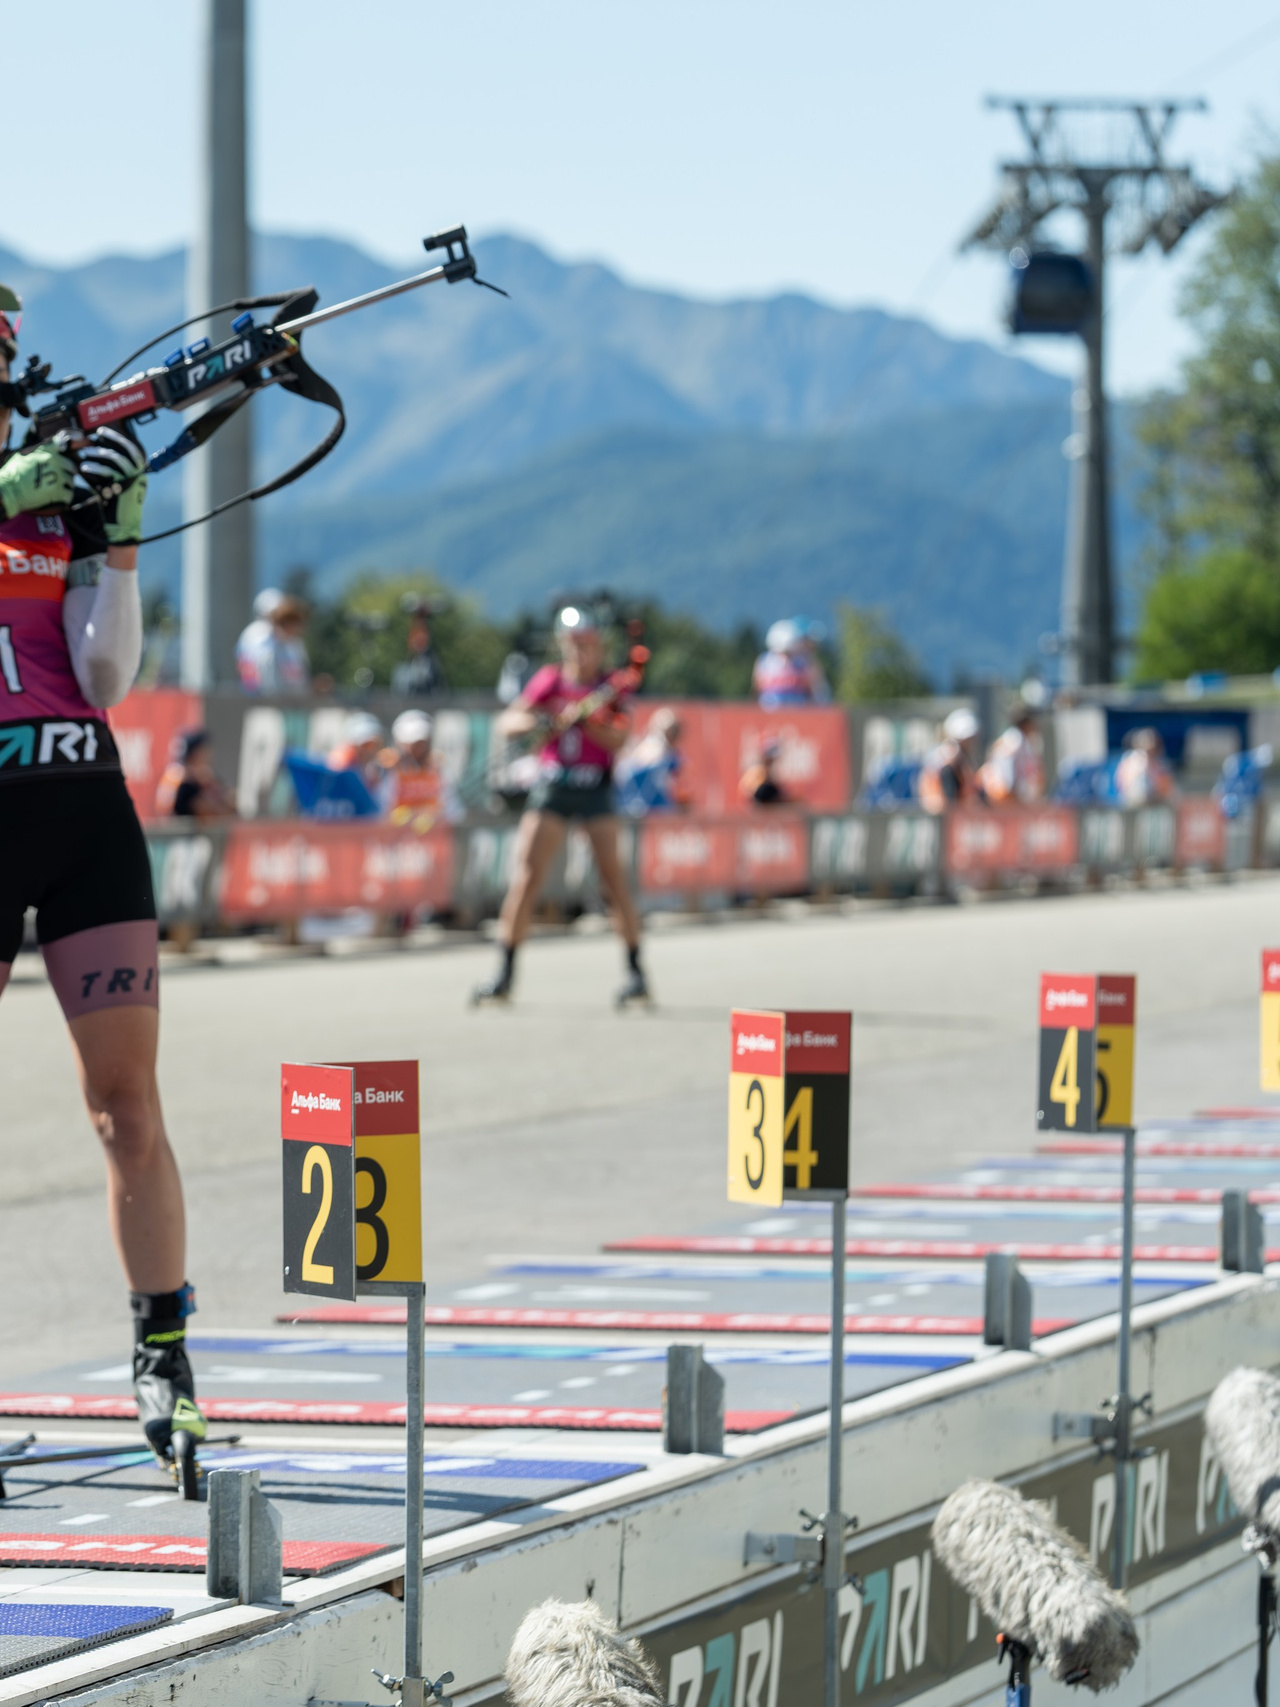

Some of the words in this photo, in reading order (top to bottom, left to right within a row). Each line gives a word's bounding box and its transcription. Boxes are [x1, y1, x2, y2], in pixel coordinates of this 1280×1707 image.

[186, 339, 252, 390] PARI
[291, 1090, 319, 1112] Альфа
[319, 1093, 342, 1112] Банк
[365, 1087, 405, 1104] Банк
[1049, 1025, 1081, 1128] 4
[745, 1079, 765, 1191] 3
[783, 1086, 819, 1190] 4
[301, 1144, 334, 1285] 2
